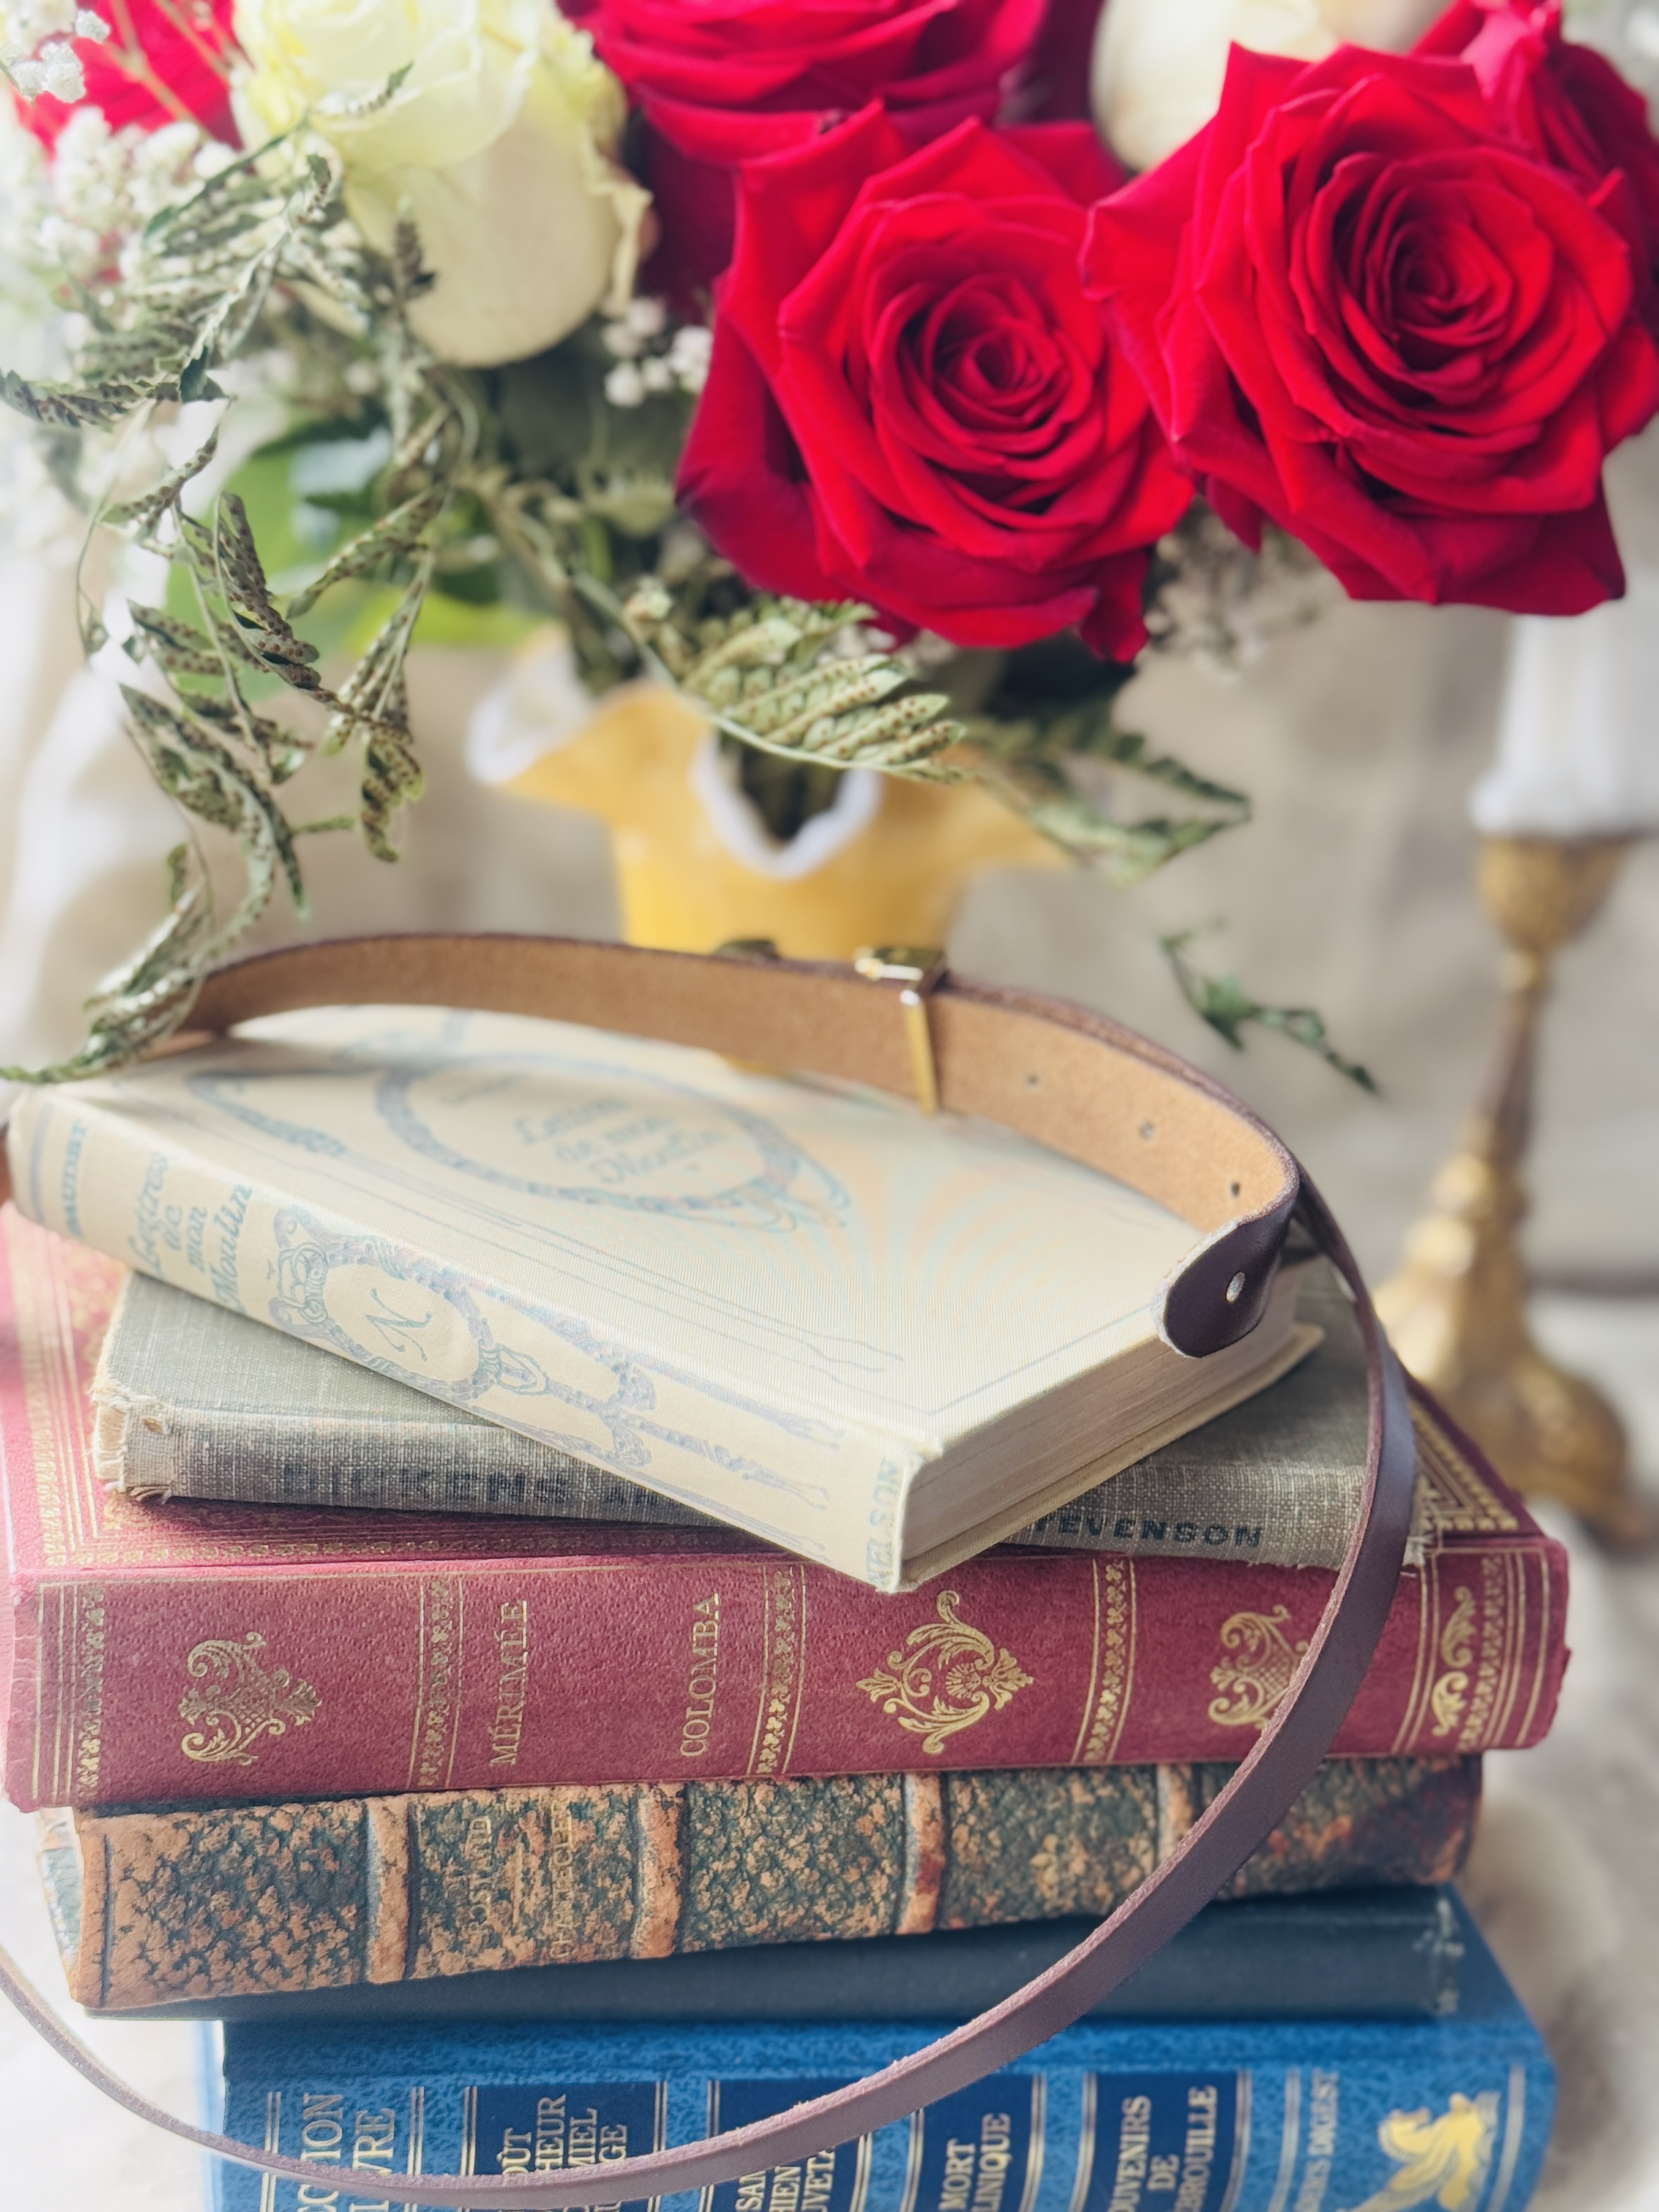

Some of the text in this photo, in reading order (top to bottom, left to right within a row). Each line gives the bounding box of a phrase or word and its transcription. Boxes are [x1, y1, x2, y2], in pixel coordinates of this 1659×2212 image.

[127, 1152, 168, 1277] Lettres
[160, 1204, 183, 1251] de
[187, 1207, 207, 1273] mon
[209, 1183, 253, 1314] Moulin
[282, 1462, 571, 1504] DICKENS
[1035, 1514, 1263, 1548] TEVENSON
[489, 1599, 528, 1766] MÉRIMÉE
[679, 1592, 719, 1757] COLOMBA
[939, 2138, 975, 2211] MORT
[970, 2112, 1013, 2212] LINIQUE
[1107, 2095, 1152, 2212] OUVENIRS
[1147, 2154, 1180, 2191] DE
